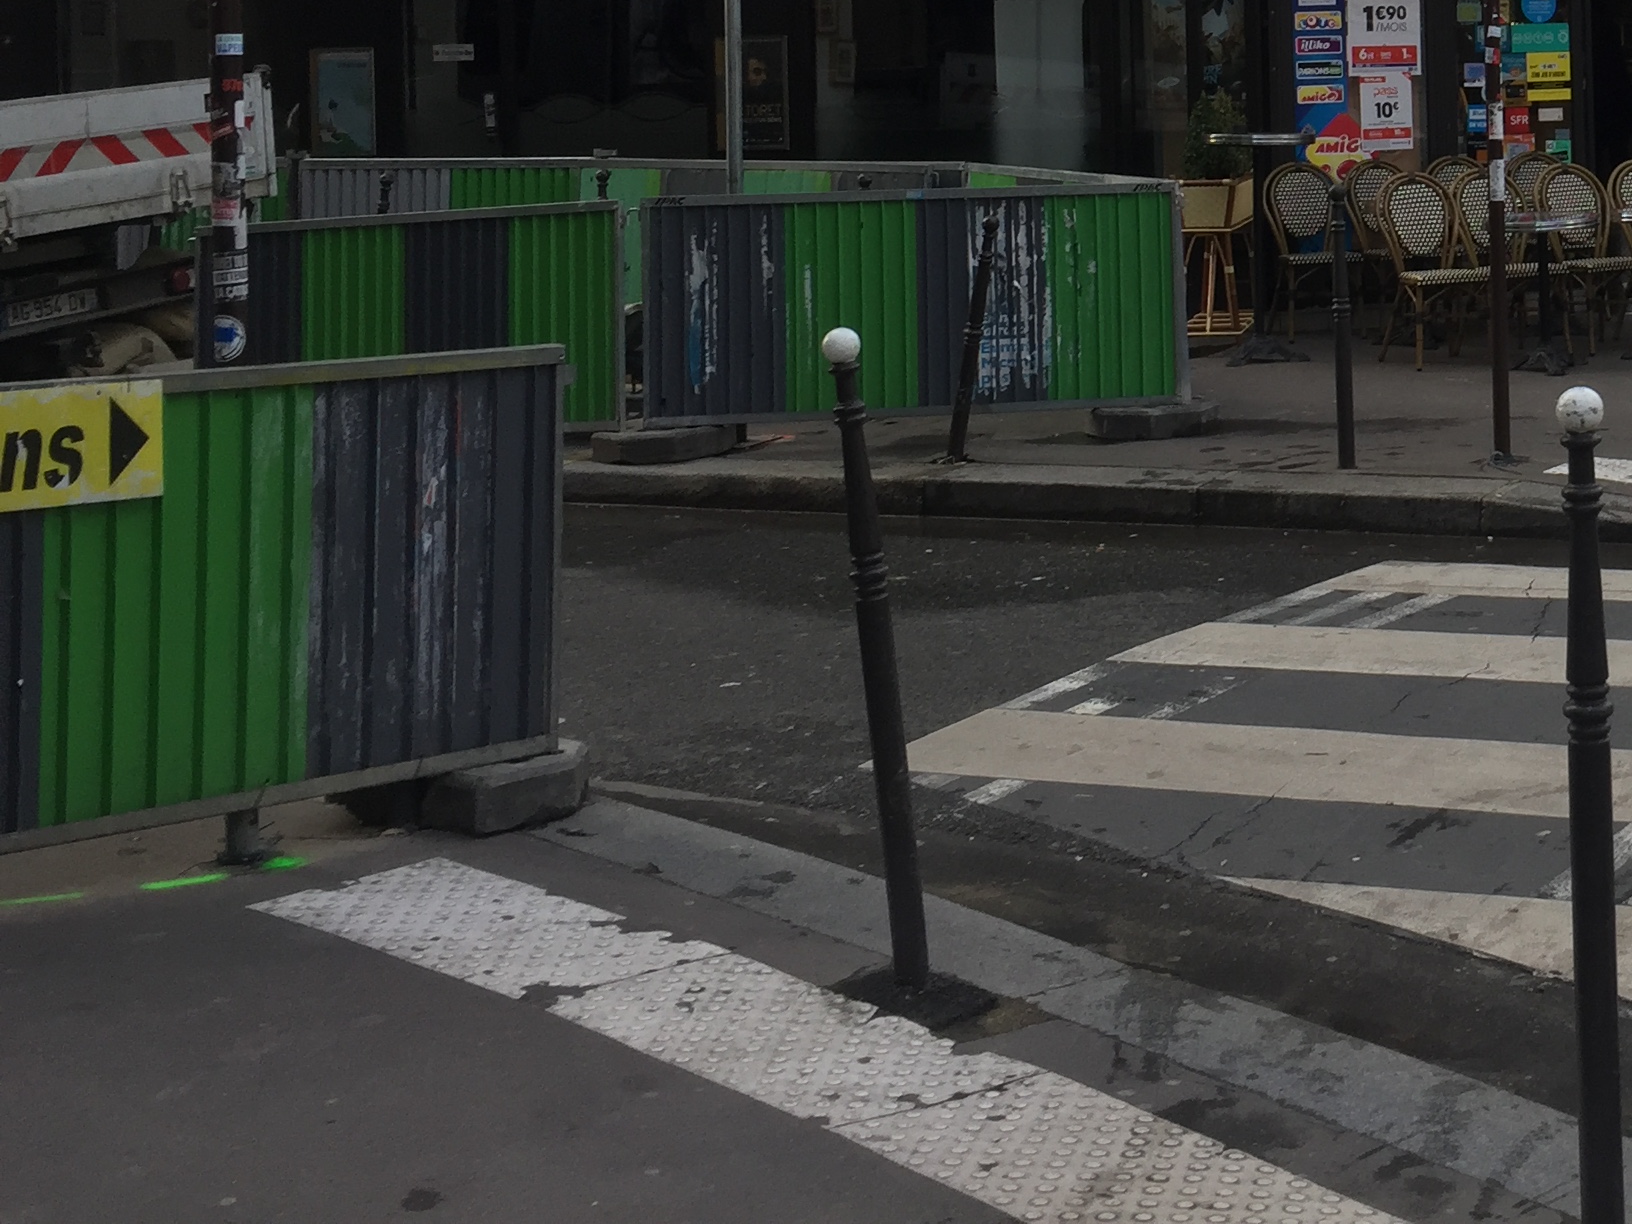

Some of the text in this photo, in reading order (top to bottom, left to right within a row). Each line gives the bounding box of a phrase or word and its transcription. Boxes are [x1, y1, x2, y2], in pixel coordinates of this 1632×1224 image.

[1300, 39, 1331, 51] illiko
[1301, 91, 1339, 103] AMIGO
[1375, 102, 1399, 118] 10€
[1509, 115, 1529, 125] SFR
[1314, 135, 1362, 154] AMIG
[0, 423, 86, 494] ns
